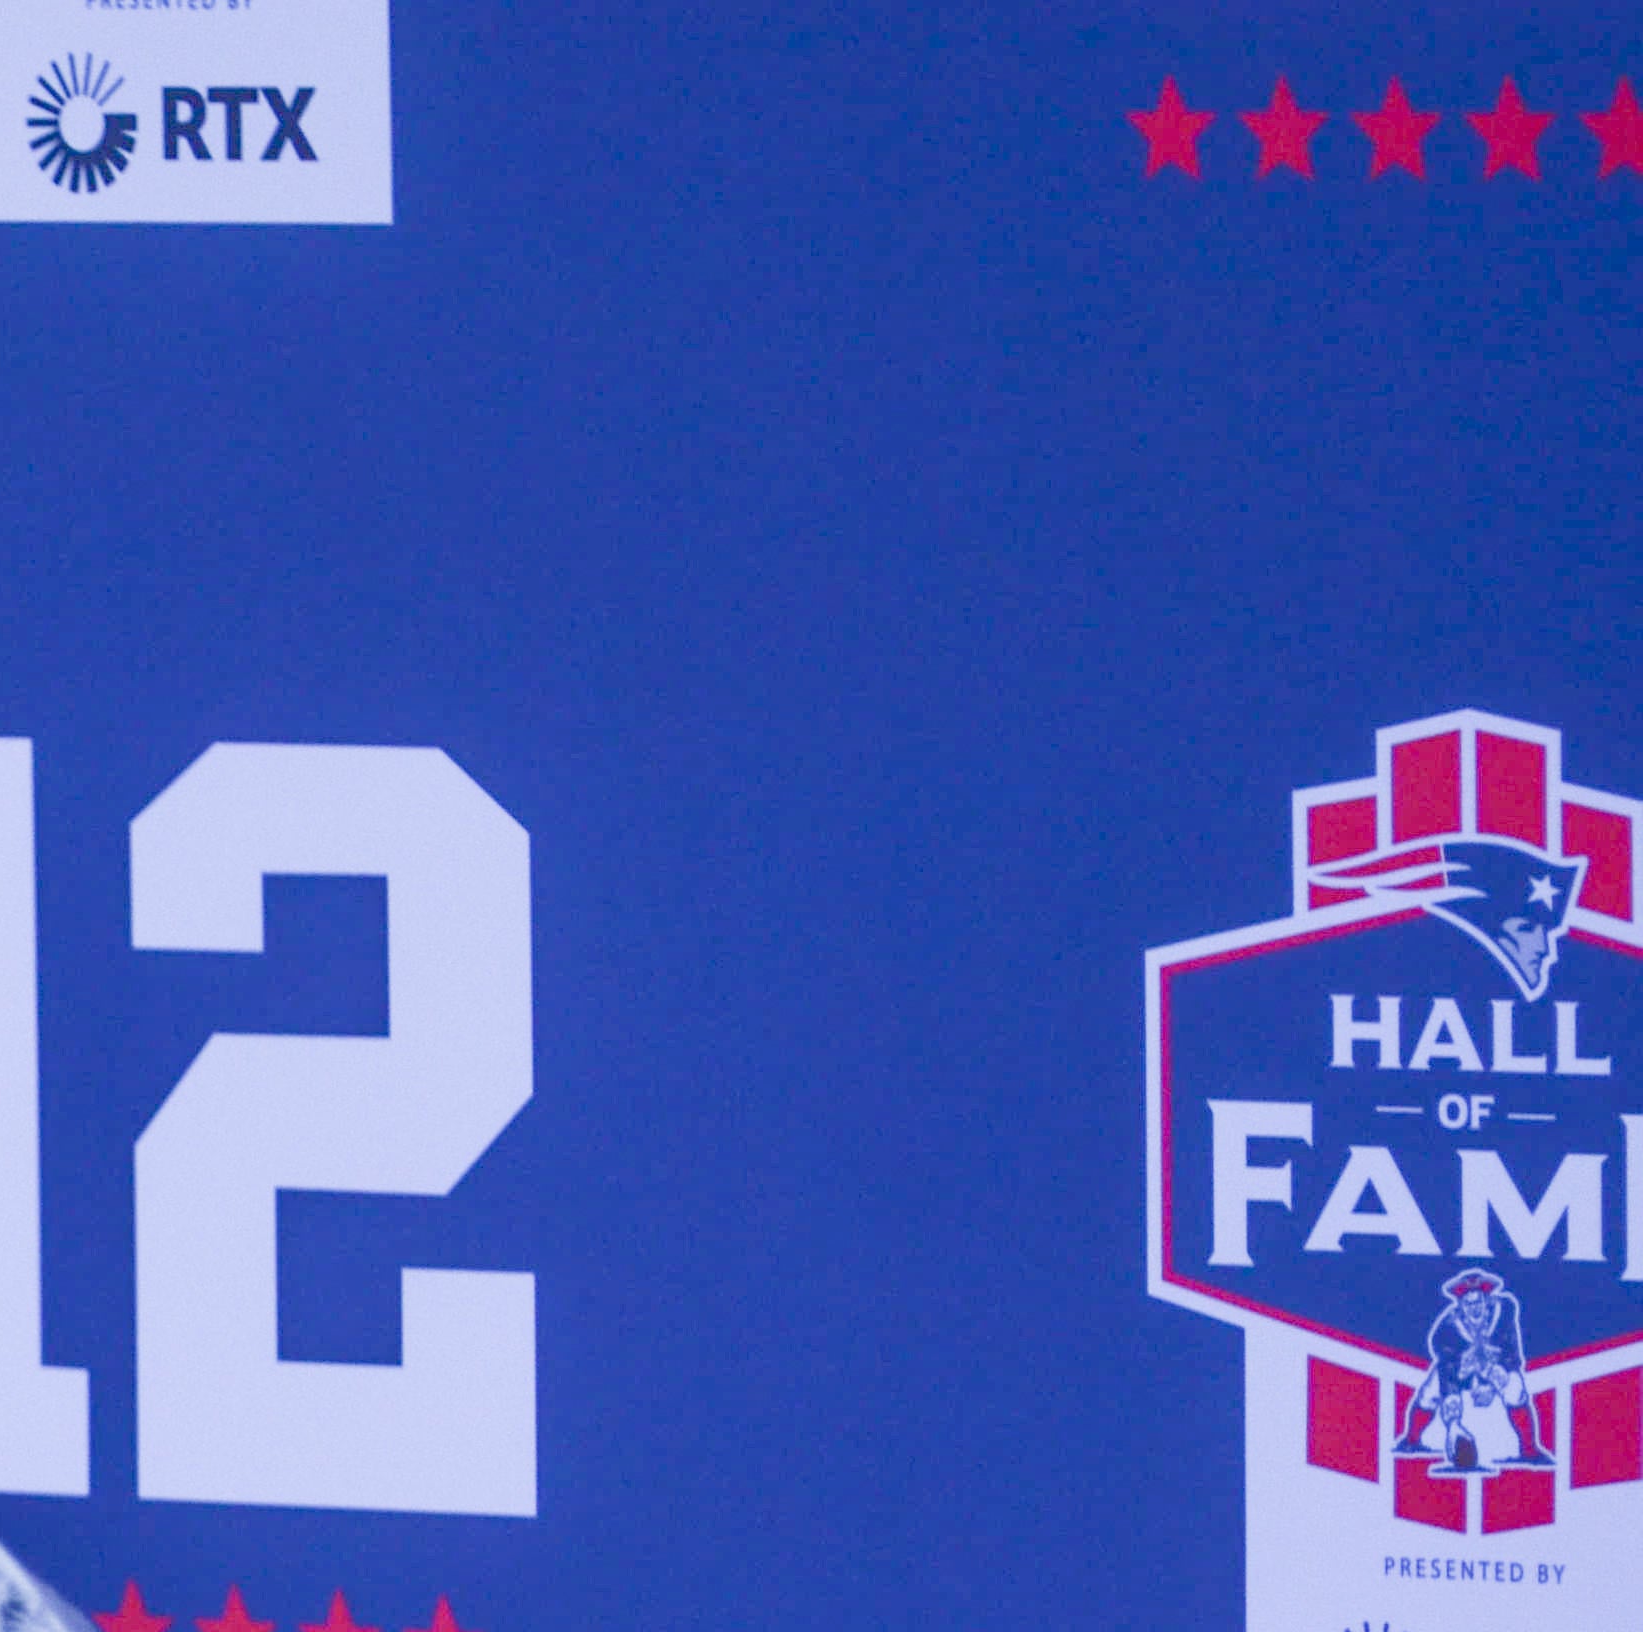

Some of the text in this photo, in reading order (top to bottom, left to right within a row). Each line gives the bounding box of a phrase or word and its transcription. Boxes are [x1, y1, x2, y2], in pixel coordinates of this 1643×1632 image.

[161, 85, 319, 162] RTX
[1329, 993, 1612, 1076] HALL
[1437, 1093, 1496, 1131] OF
[1383, 1555, 1566, 1585] PRESENTED BY
